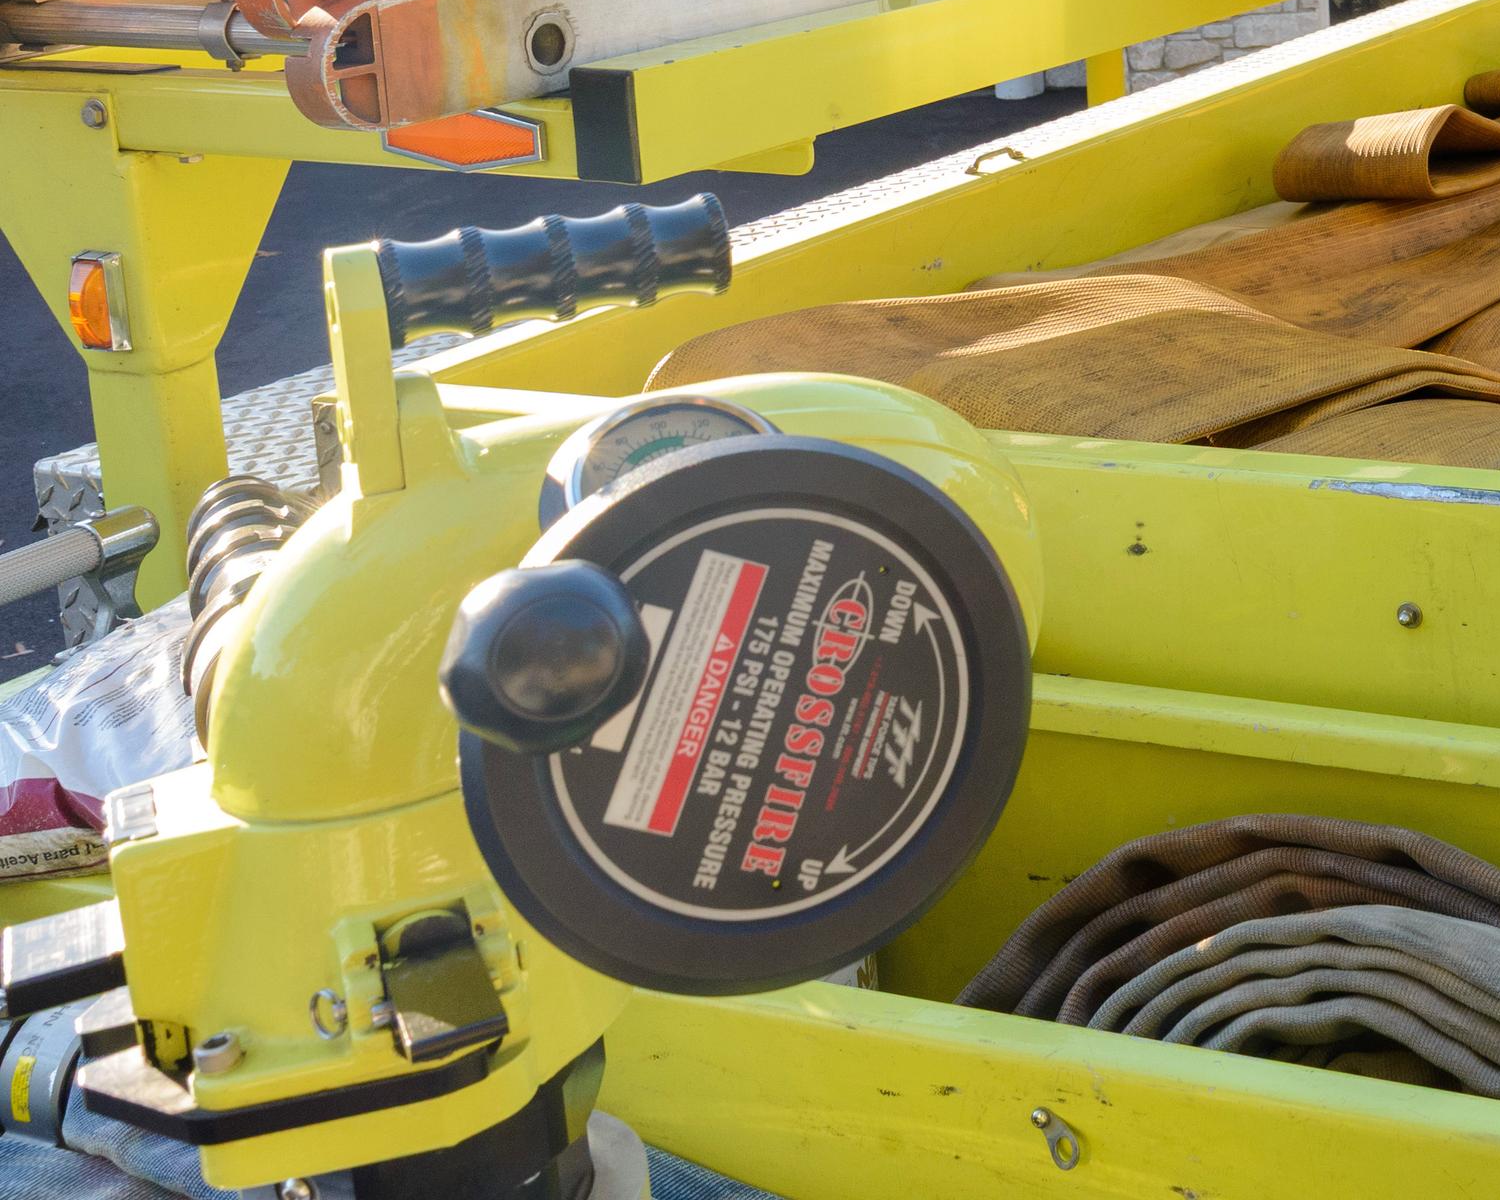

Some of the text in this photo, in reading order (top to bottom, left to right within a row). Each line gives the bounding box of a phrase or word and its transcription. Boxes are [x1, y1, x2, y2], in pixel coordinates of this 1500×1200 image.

[879, 581, 916, 643] DOWN
[749, 617, 778, 655] 175
[733, 659, 764, 696] PSI
[677, 659, 729, 758] DANGER
[694, 540, 834, 889] MAXIMUM OPERATING PRESSURE
[716, 720, 742, 745] 12
[741, 598, 868, 878] CROSSFIRE
[697, 750, 731, 795] BAR
[44, 845, 80, 861] para
[798, 860, 823, 890] UP
